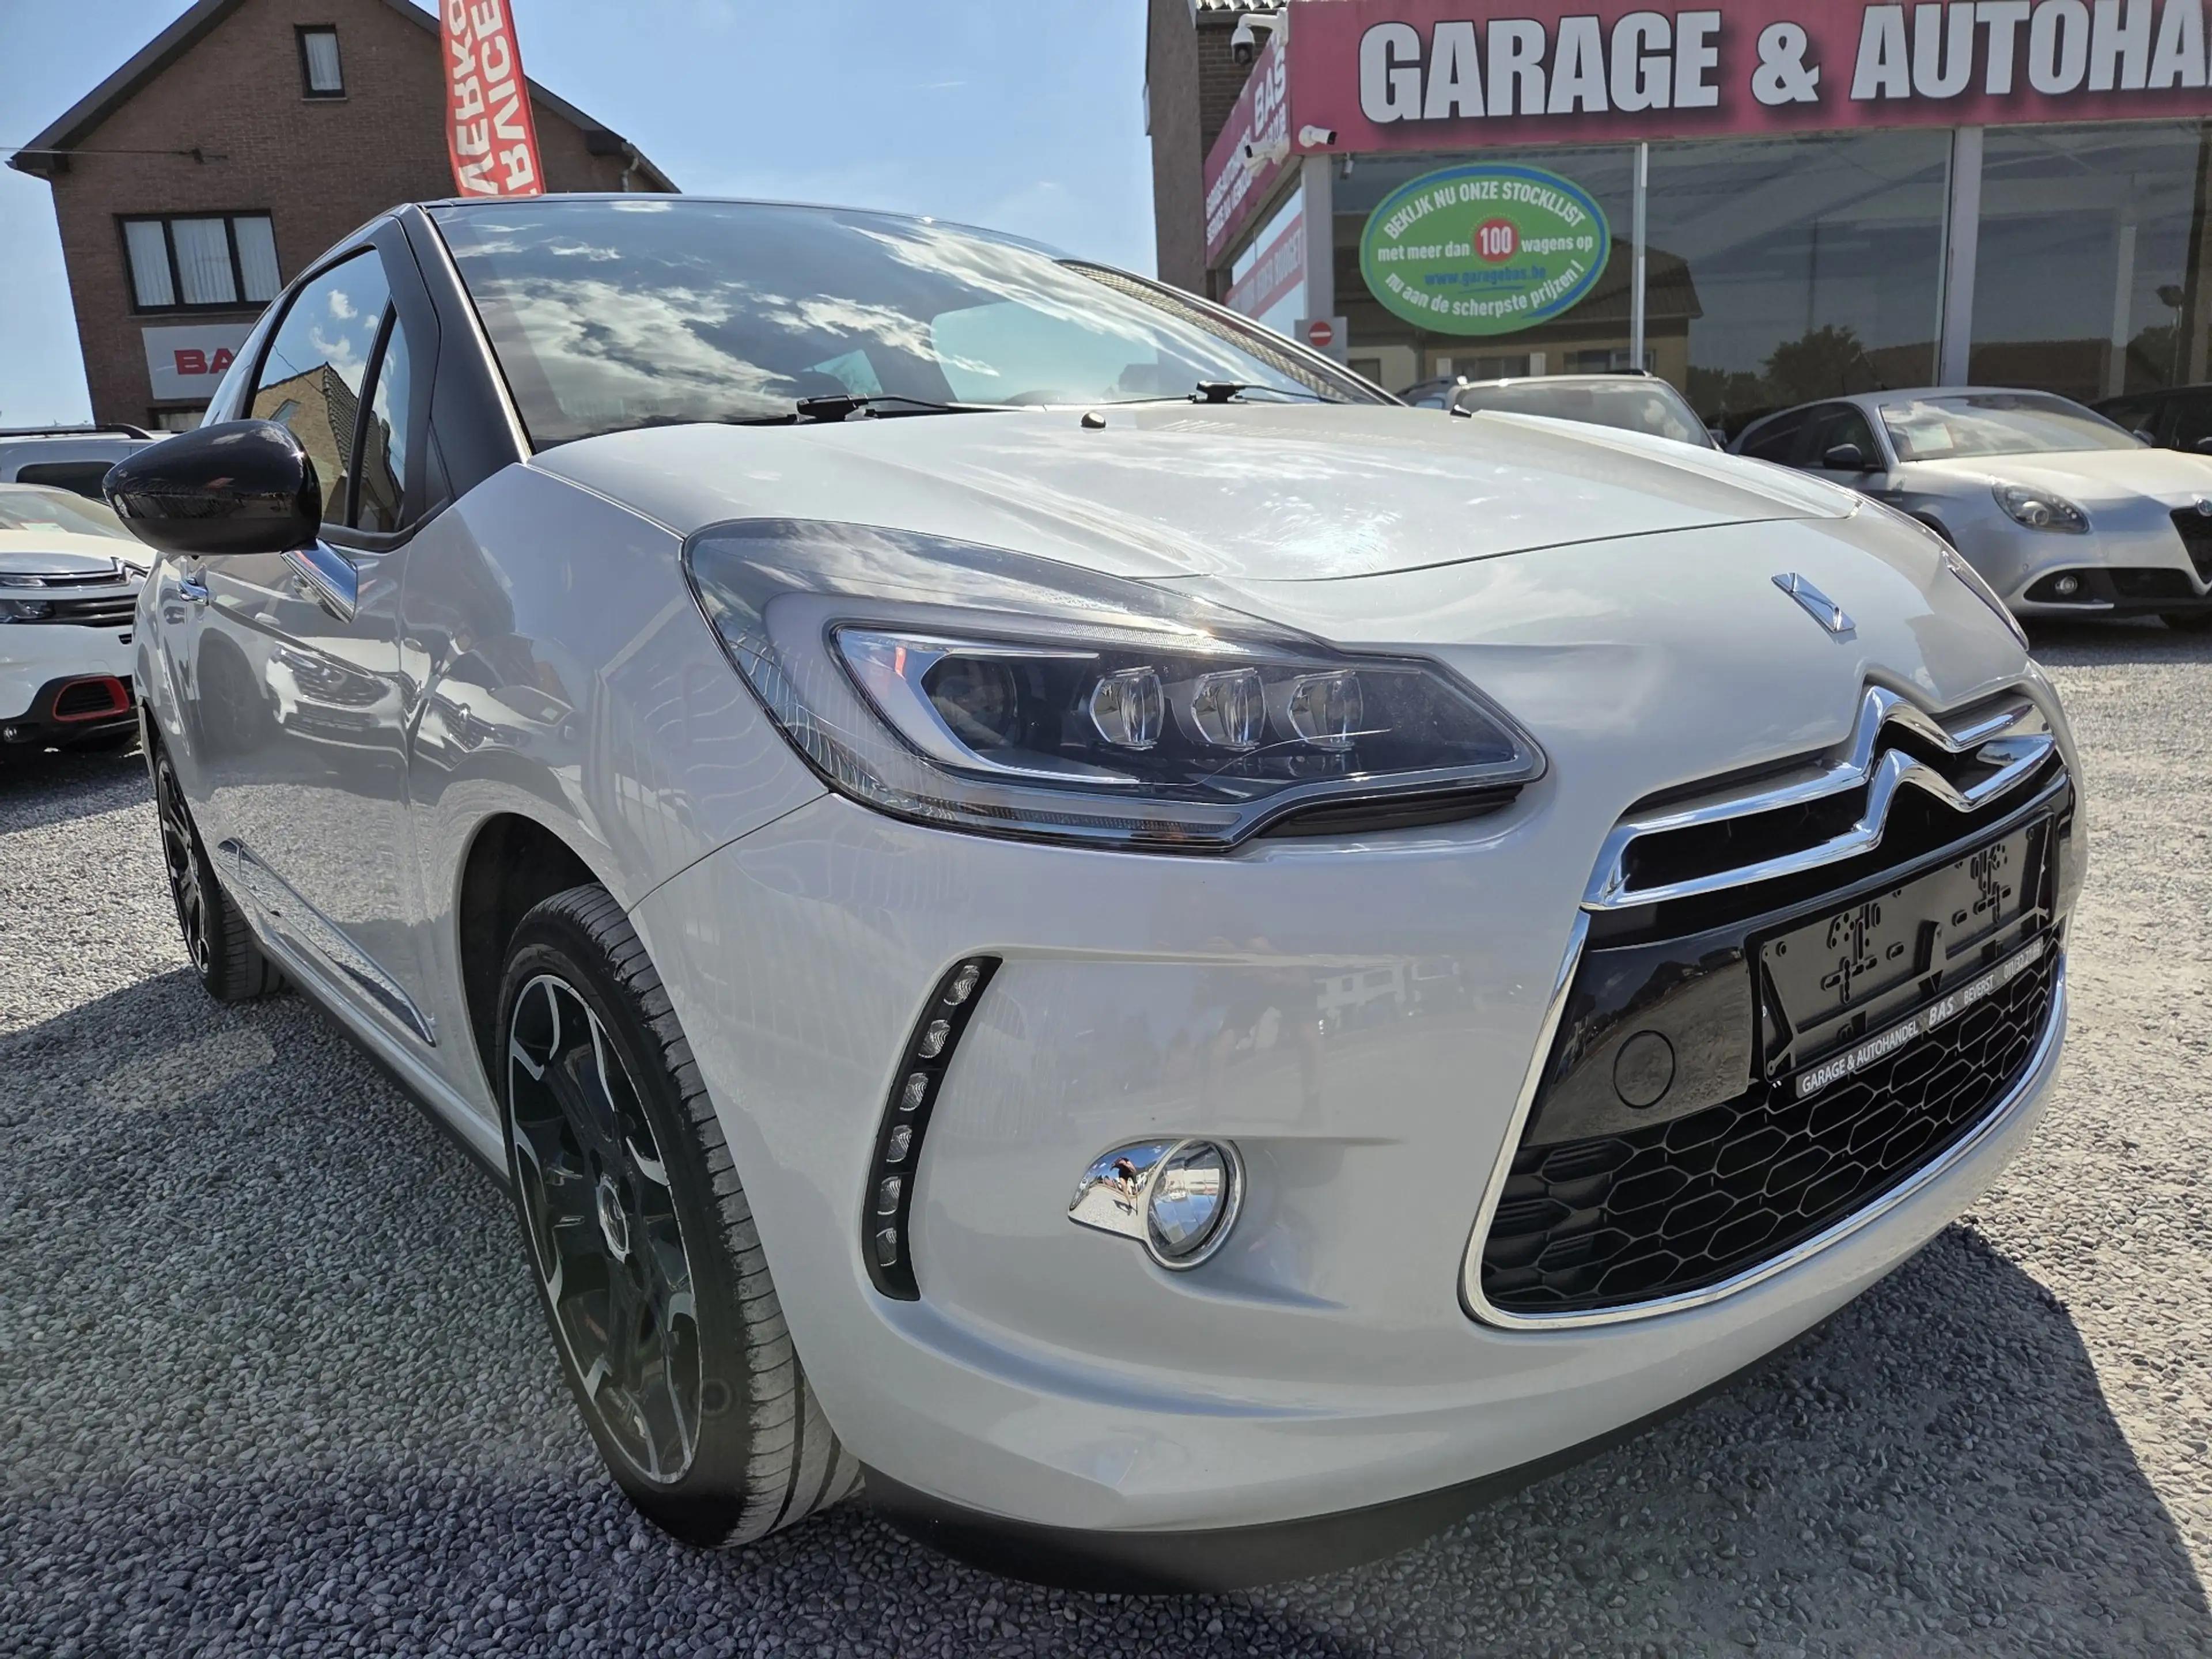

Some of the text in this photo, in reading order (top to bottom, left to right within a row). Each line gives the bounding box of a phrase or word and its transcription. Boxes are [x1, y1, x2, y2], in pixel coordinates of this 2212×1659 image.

[1255, 45, 1286, 137] BAS
[1359, 0, 2212, 123] GARAGE & AUTOHA
[1384, 181, 1586, 240] BEKIJK NU ONZE STOCKLIJST
[1378, 226, 1593, 262] met meer dan 100 wagens op
[1385, 259, 1585, 318] nu aan de scherpste prijzen !
[174, 347, 235, 375] BA
[1802, 1058, 1845, 1093] GARAGE
[1847, 1054, 1855, 1071] &
[1857, 1020, 1919, 1067] AUTOHANDEL
[1929, 996, 1954, 1027] BAS
